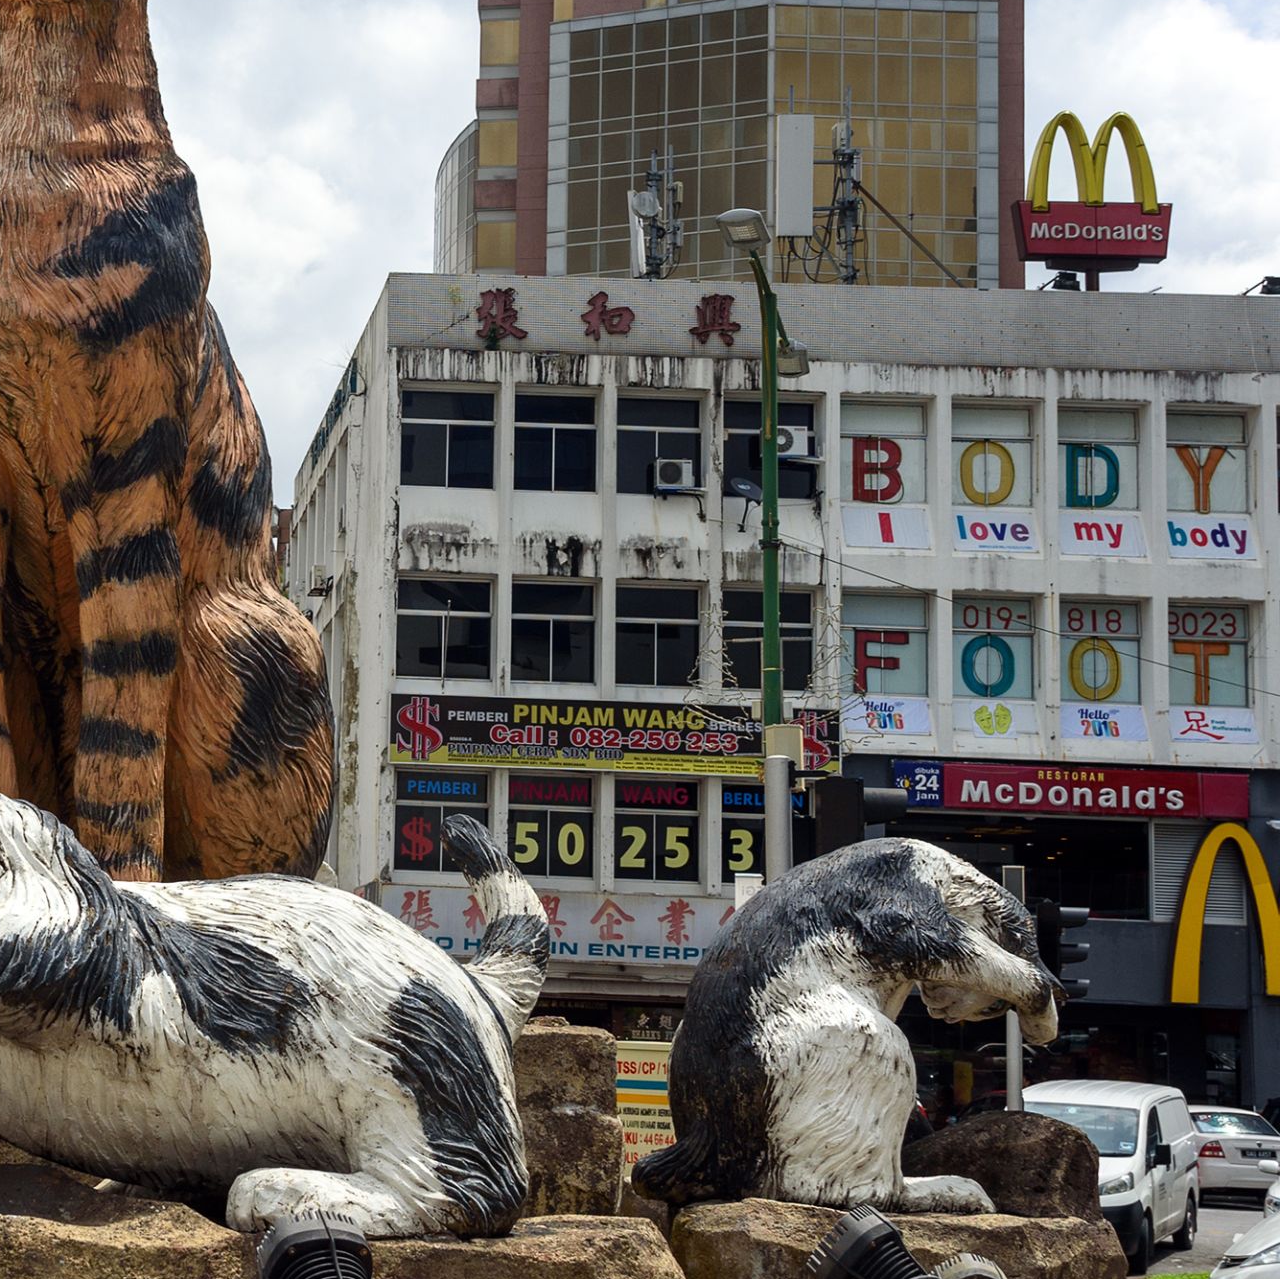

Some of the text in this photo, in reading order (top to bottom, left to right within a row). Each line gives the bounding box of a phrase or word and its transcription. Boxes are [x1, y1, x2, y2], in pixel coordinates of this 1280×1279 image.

[1030, 222, 1164, 241] McDonald's
[877, 512, 1248, 555] I love my body
[1068, 607, 1122, 633] 818
[864, 701, 894, 712] Hello
[1077, 708, 1109, 720] Hello
[447, 704, 762, 733] PEMBERI PINJAM WANG BERLES
[866, 712, 904, 729] 2016
[1180, 710, 1224, 740] 足
[1080, 720, 1119, 737] 2016
[490, 724, 543, 745] Call
[569, 727, 681, 751] 082-250
[686, 731, 739, 753] 253
[447, 743, 513, 758] PIMPINAN
[517, 745, 558, 759] CERIA
[562, 747, 590, 760] SDN
[594, 748, 624, 760] BHD
[914, 767, 939, 775] dibuka
[1038, 770, 1105, 782] RESTORAN
[407, 779, 477, 796] PEMBERI
[510, 781, 588, 802] PINJAM
[914, 775, 939, 791] 24
[622, 786, 689, 805] WANG
[916, 791, 939, 801] jam
[960, 780, 1184, 810] McDonald's
[588, 942, 705, 960] ENTERP
